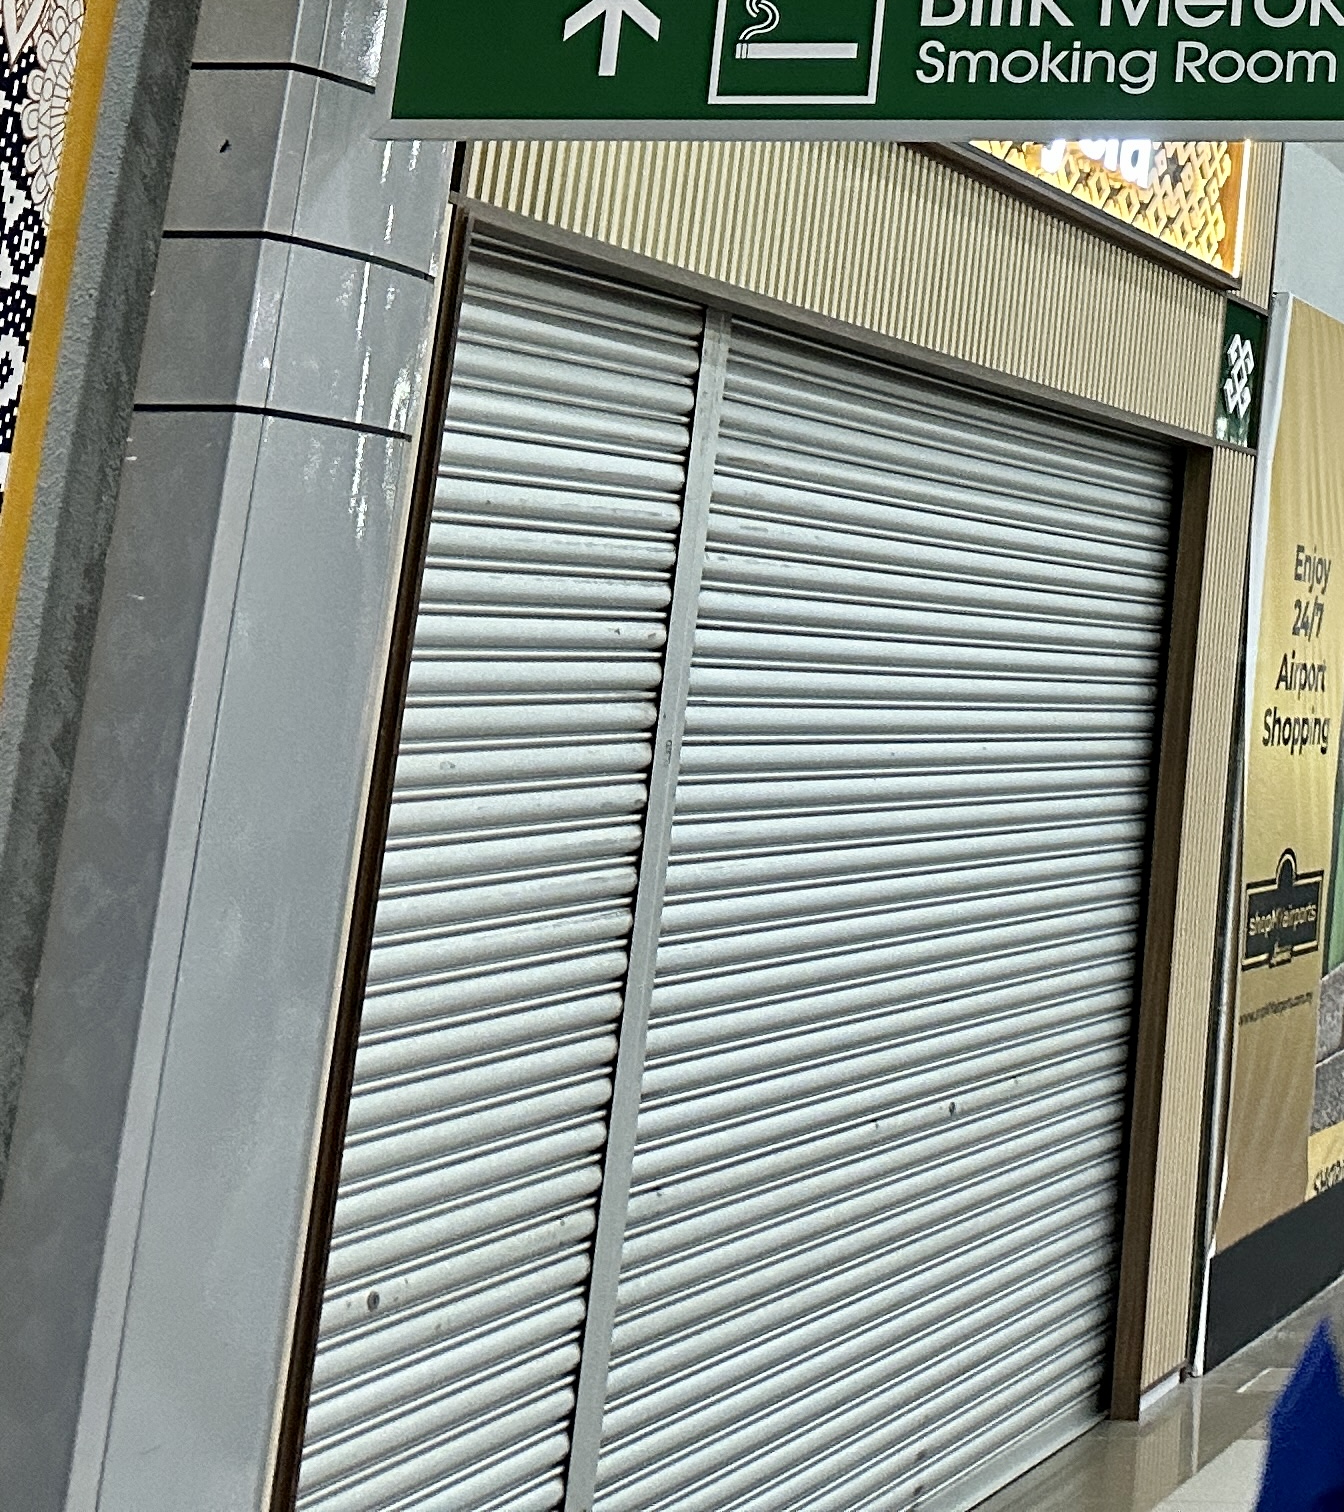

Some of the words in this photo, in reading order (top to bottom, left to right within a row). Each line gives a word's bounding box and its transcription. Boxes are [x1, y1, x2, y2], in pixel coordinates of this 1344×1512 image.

[915, 40, 1158, 95] Smoking
[1175, 40, 1338, 84] Room
[1293, 543, 1332, 591] Enjoy
[1291, 596, 1326, 643] 24/7
[1275, 649, 1327, 696] Airport
[1262, 705, 1330, 755] Shopping
